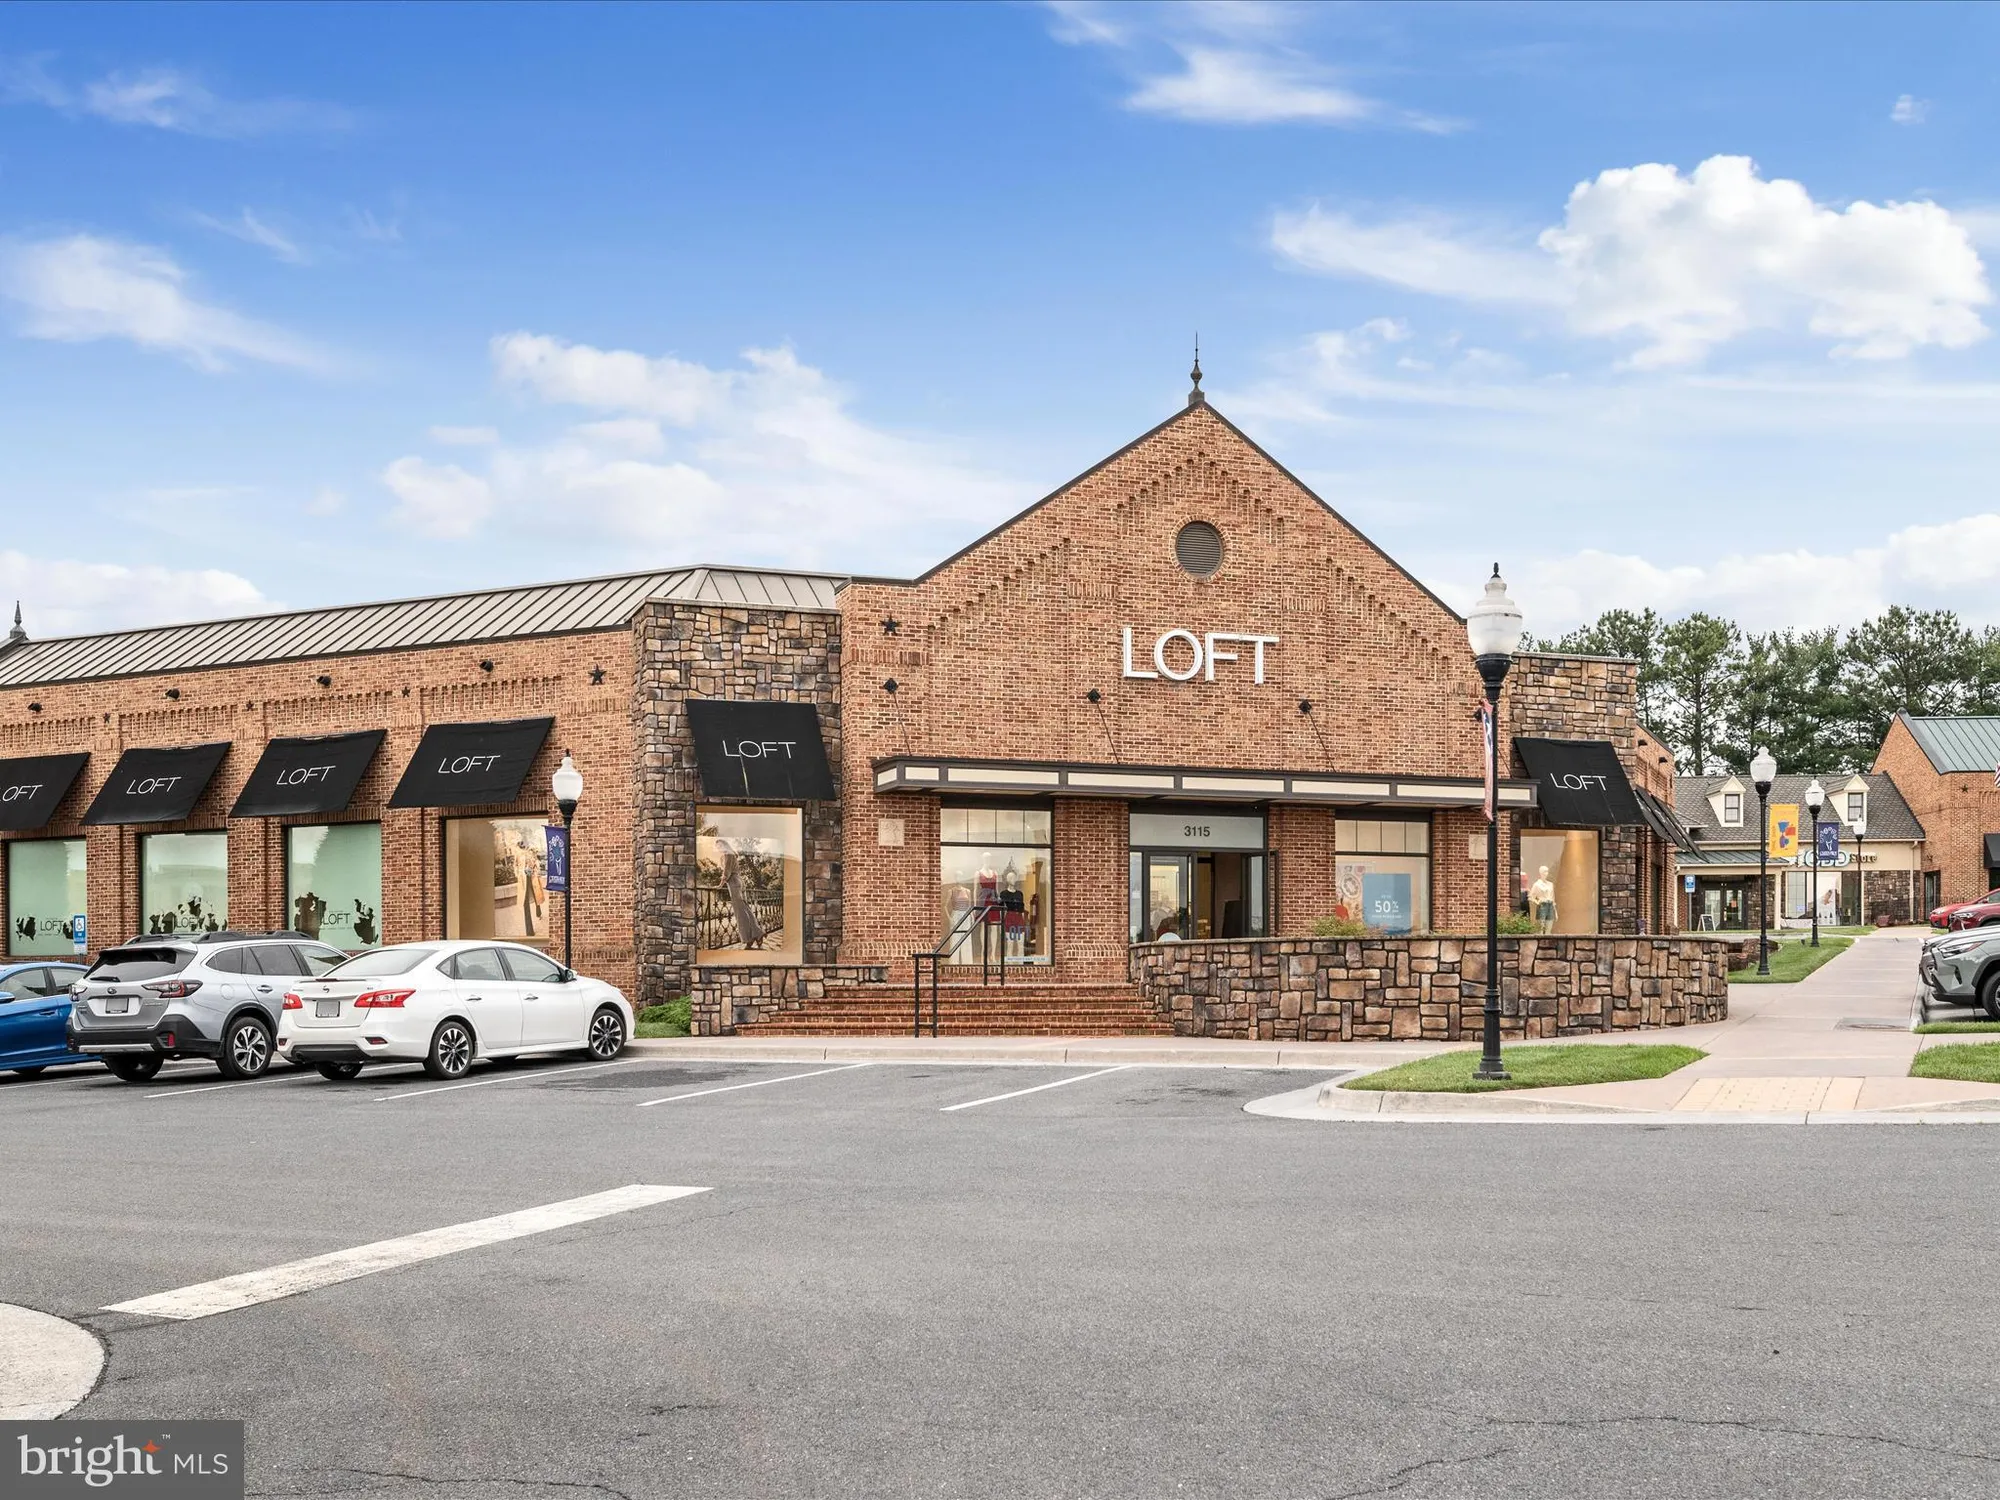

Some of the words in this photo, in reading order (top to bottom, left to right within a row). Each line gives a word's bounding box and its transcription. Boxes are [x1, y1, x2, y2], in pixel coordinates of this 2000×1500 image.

[1122, 627, 1280, 685] LOFT
[722, 740, 797, 759] LOFT
[437, 755, 501, 774] LOFT
[276, 765, 337, 785] LOFT
[1550, 772, 1607, 791] LOFT
[0, 784, 44, 802] OFT
[126, 776, 182, 795] LOFT
[1184, 826, 1211, 837] 3115
[40, 920, 64, 932] LOFT
[322, 912, 352, 926] LOFT
[1005, 925, 1031, 941] OFT
